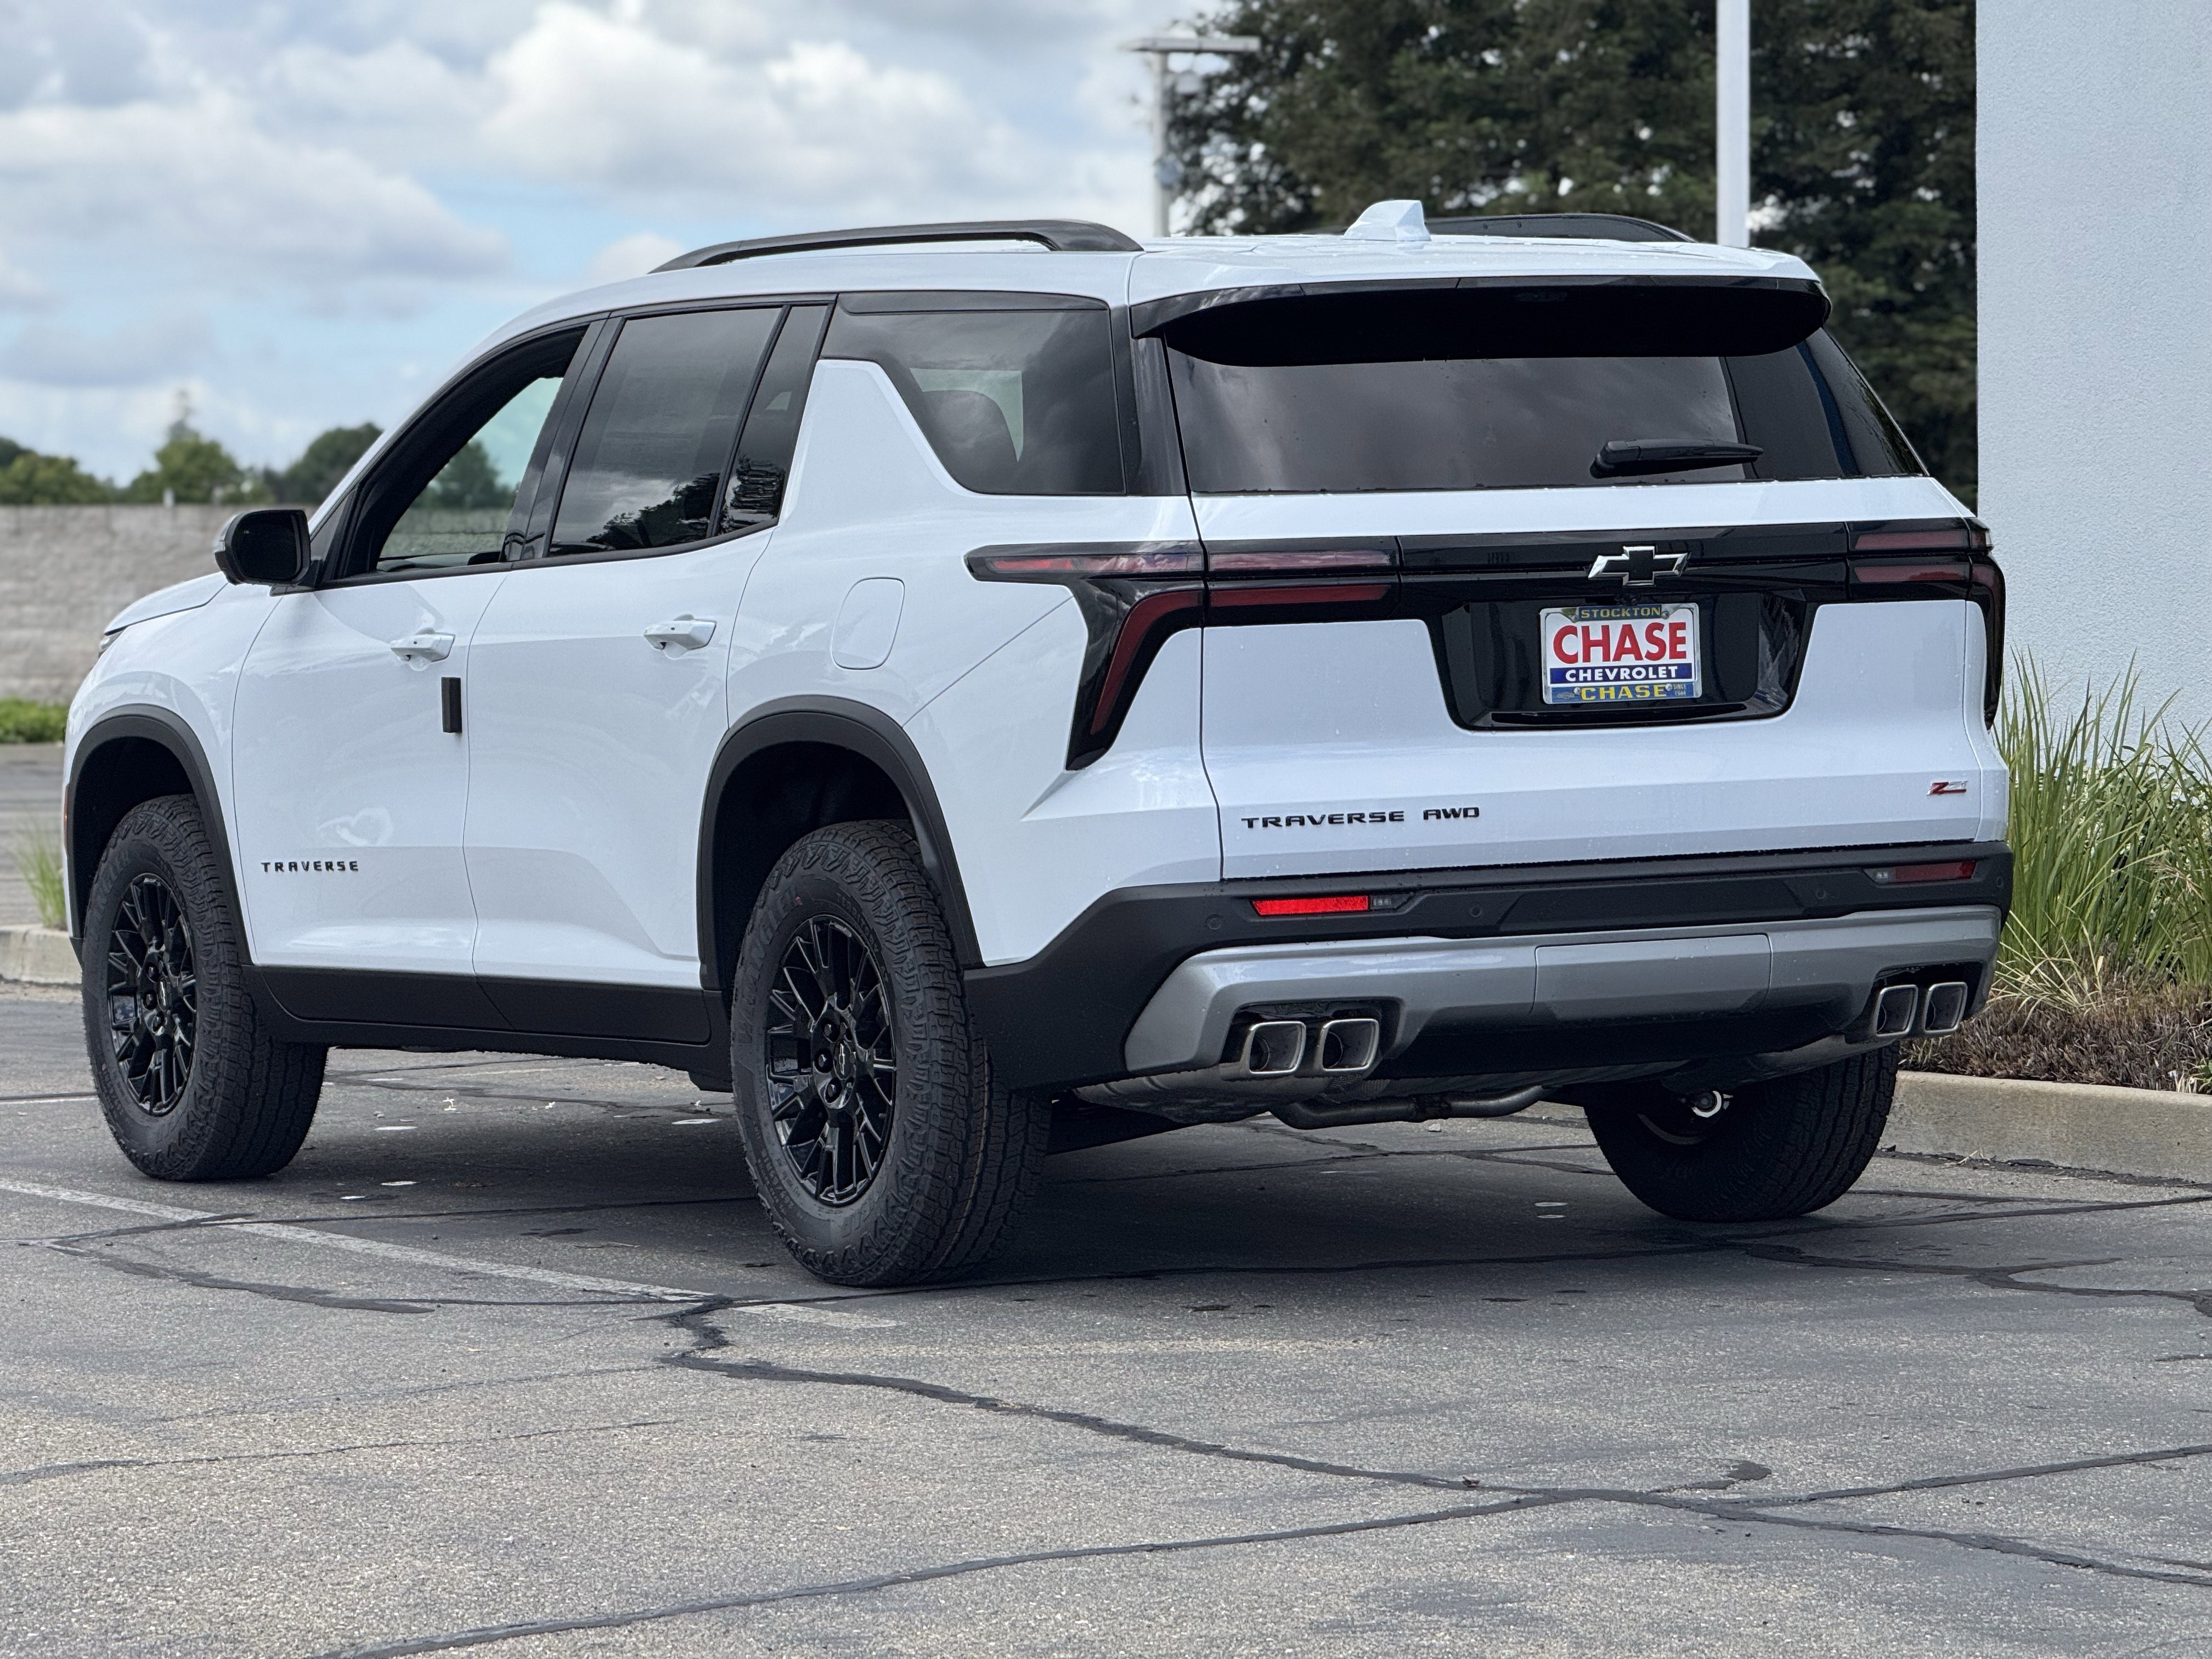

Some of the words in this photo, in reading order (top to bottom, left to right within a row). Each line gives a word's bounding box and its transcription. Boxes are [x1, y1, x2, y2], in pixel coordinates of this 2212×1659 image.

[1581, 607, 1661, 618] STOCKTON
[1553, 622, 1686, 664] CHASE
[1566, 666, 1678, 682] CHEVROLET
[1581, 685, 1666, 701] CHASE
[1241, 811, 1405, 828] TRAVERSE
[1423, 807, 1480, 820] AWD
[261, 861, 358, 872] TRAVERSE
